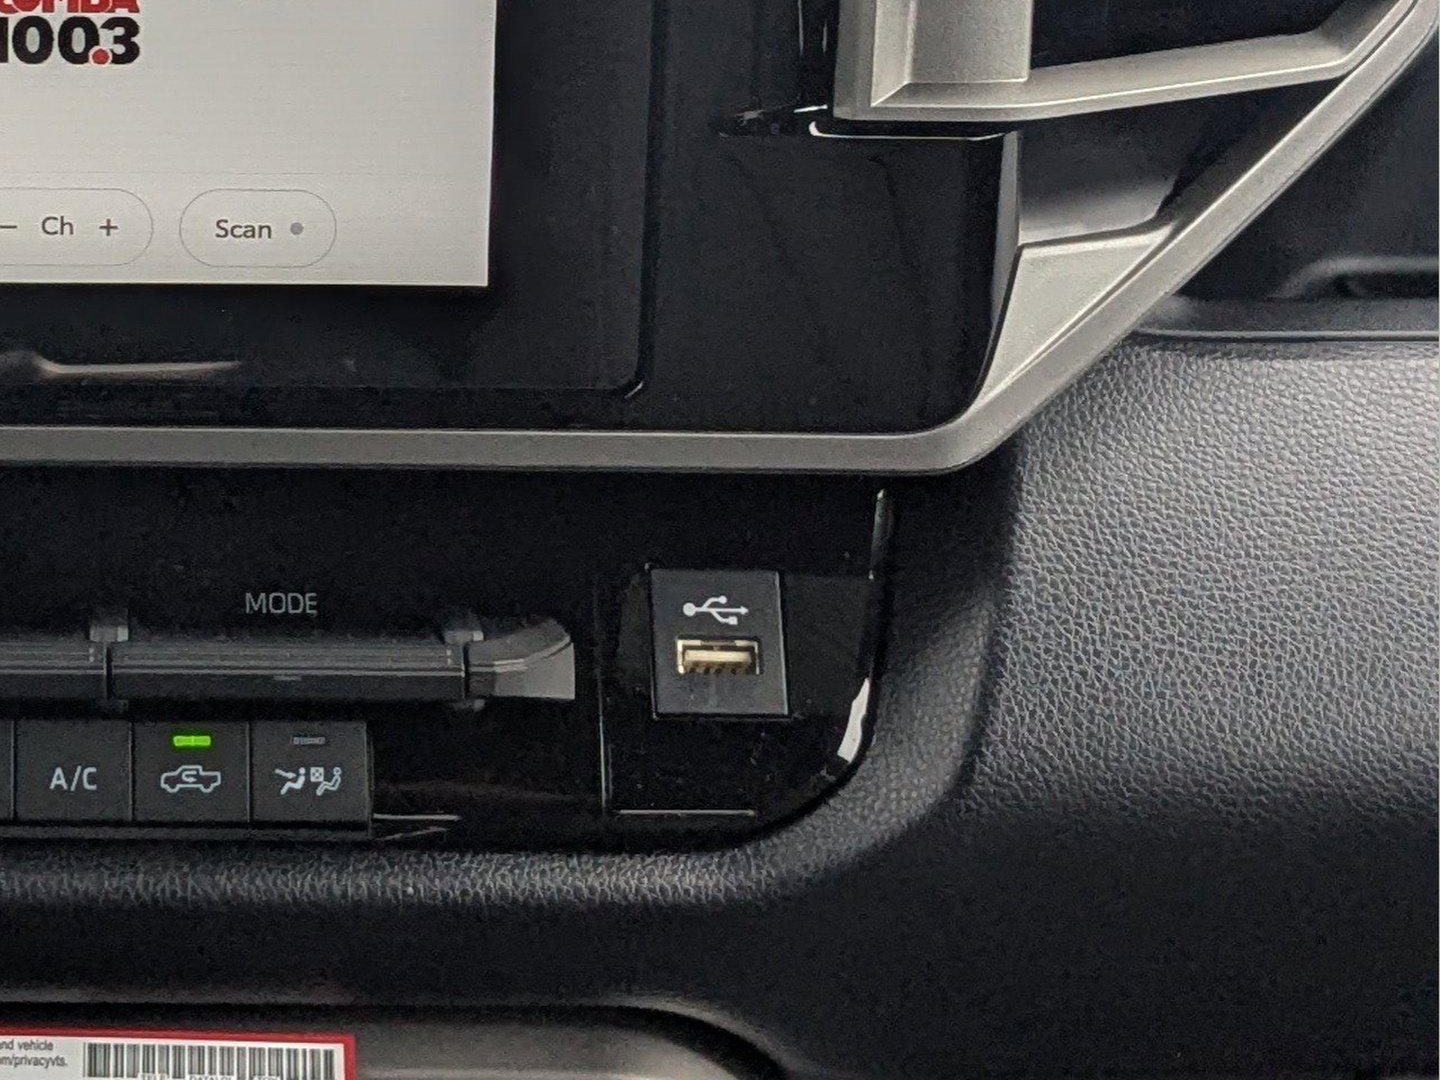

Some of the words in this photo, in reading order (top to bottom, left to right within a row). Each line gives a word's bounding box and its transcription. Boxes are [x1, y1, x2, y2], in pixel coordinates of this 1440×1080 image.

[41, 217, 74, 236] Ch
[215, 219, 272, 239] Scan
[244, 593, 318, 615] MODE
[48, 766, 97, 792] A/C
[17, 1039, 54, 1051] vehicle
